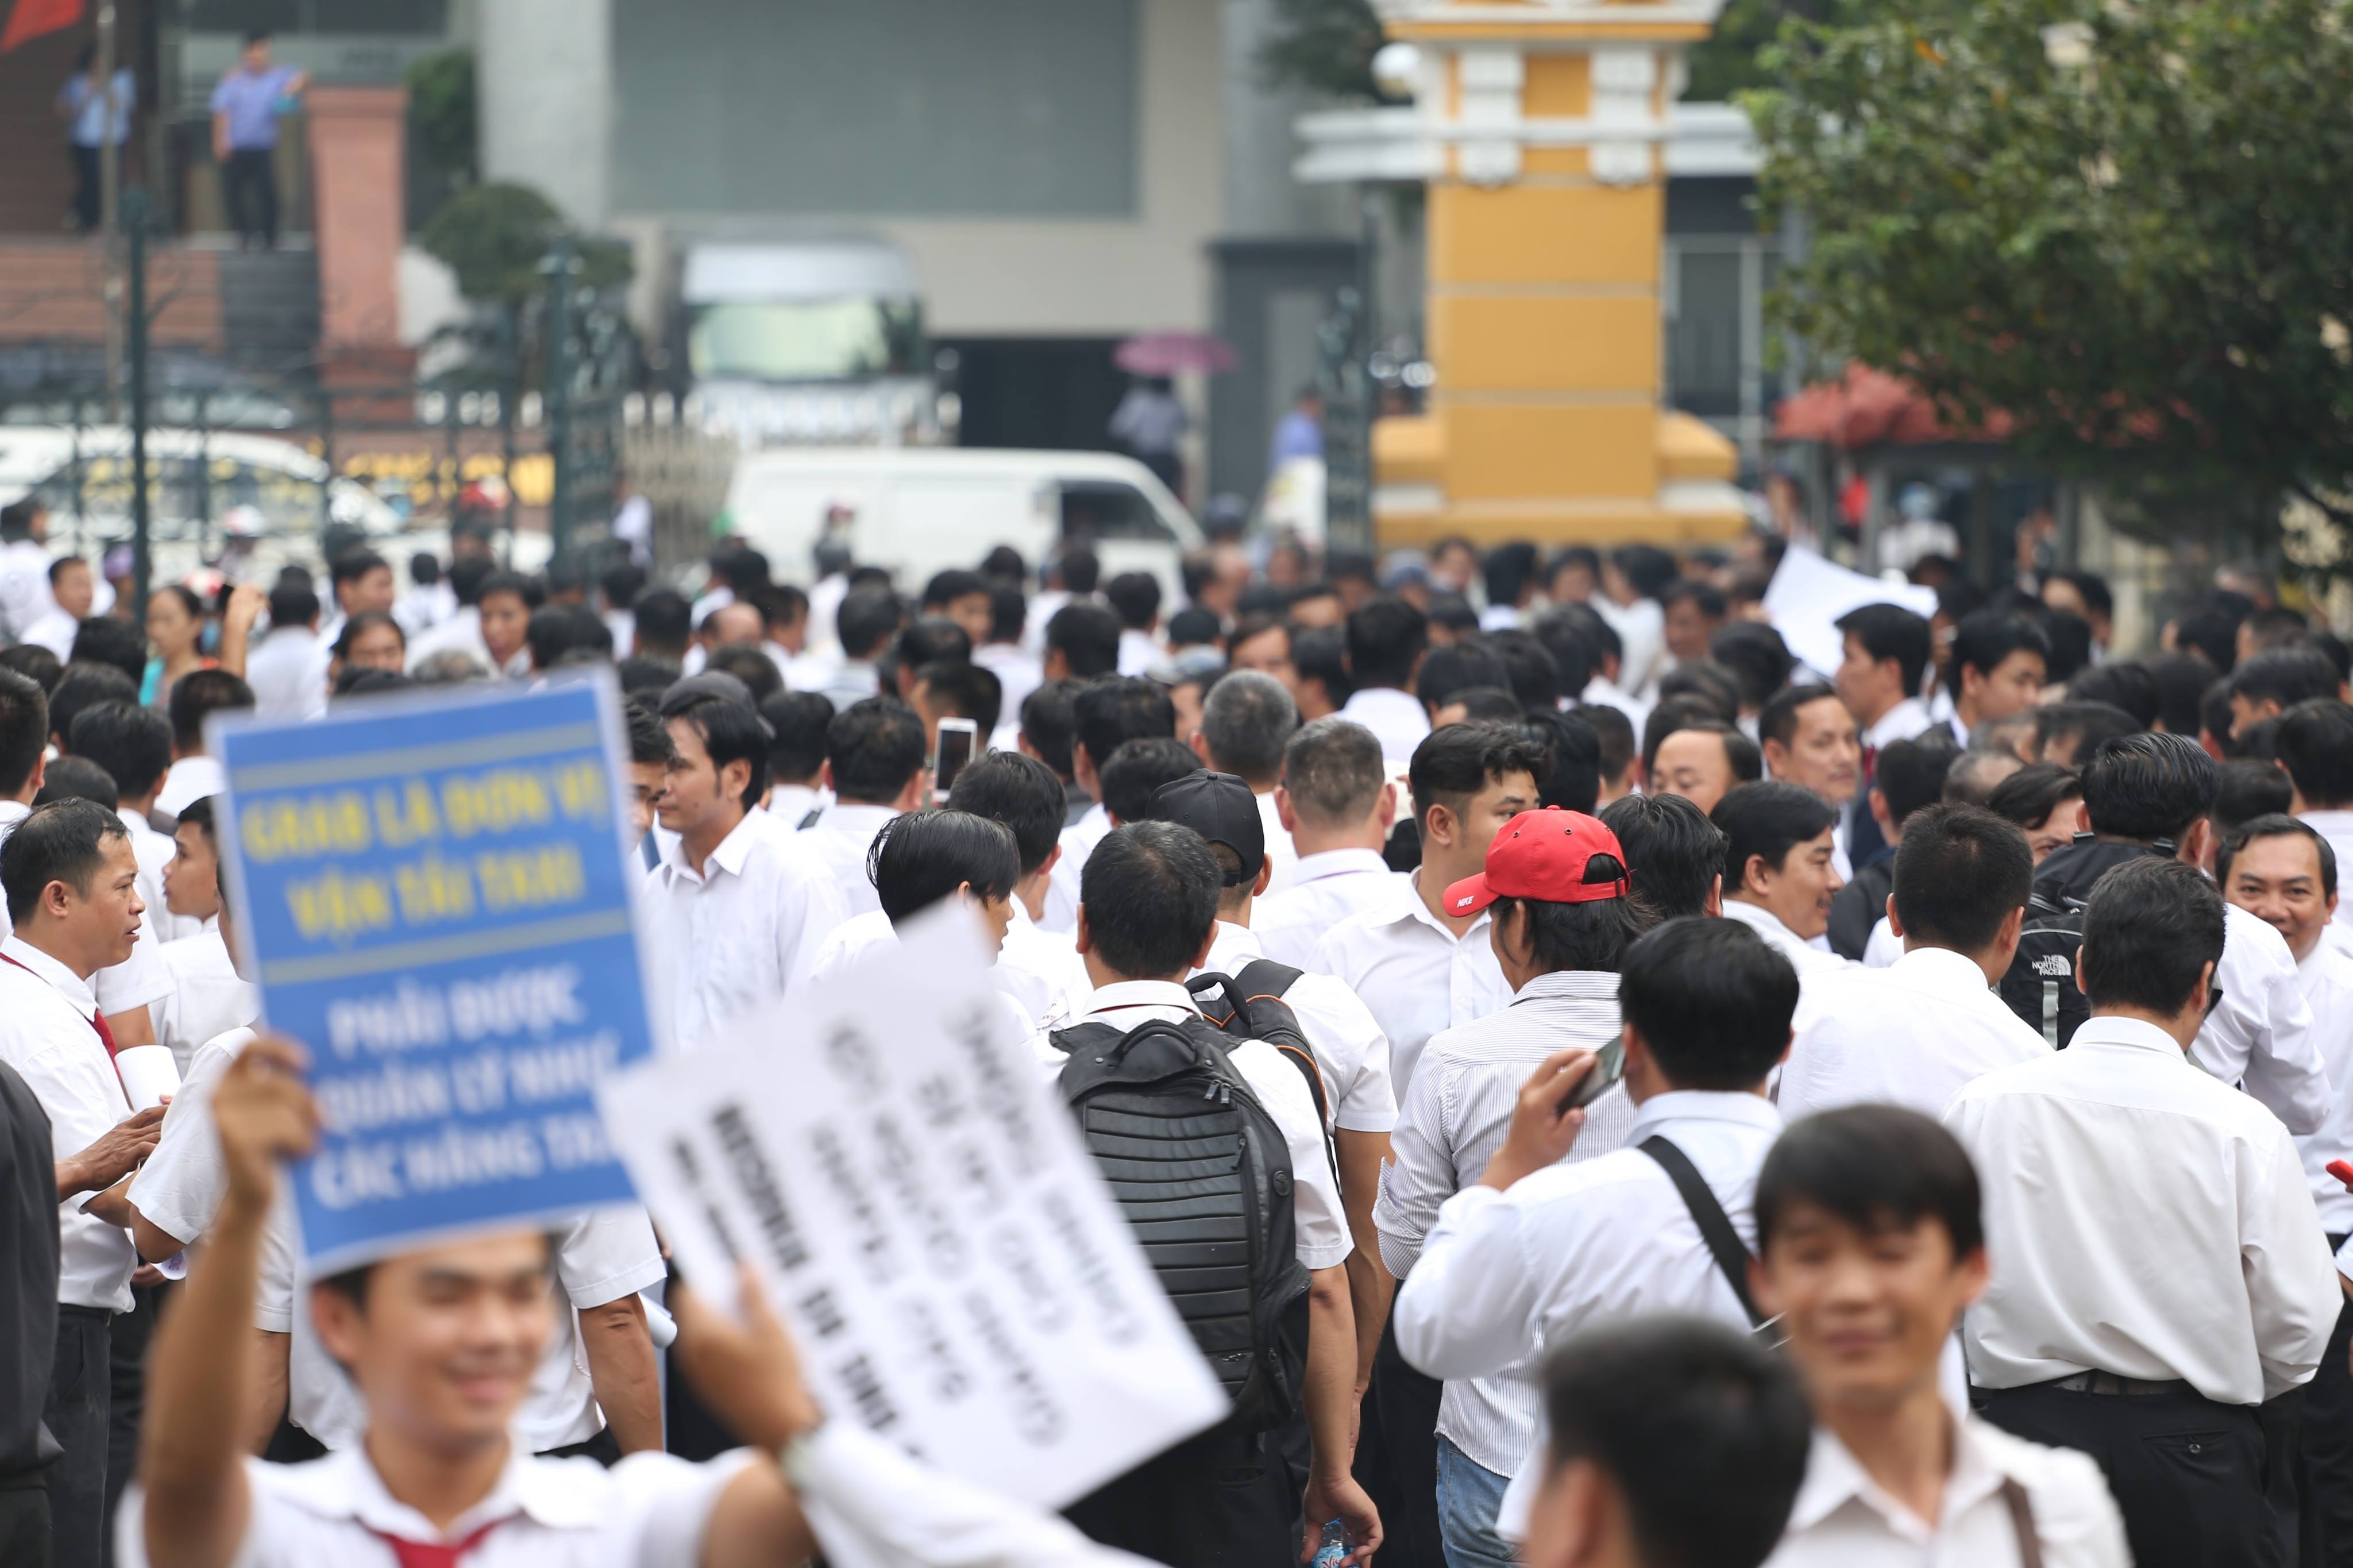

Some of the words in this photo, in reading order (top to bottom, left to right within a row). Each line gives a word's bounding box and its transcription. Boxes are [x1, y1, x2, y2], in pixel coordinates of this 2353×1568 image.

[242, 791, 371, 862] GRAB
[376, 777, 440, 847] LÀ
[443, 765, 551, 836] ĐƠN
[289, 864, 392, 946] VẬN
[477, 843, 585, 913] TAXI
[1456, 895, 1474, 908] NIKE
[2032, 961, 2059, 970] NORTH
[2042, 955, 2059, 963] THE
